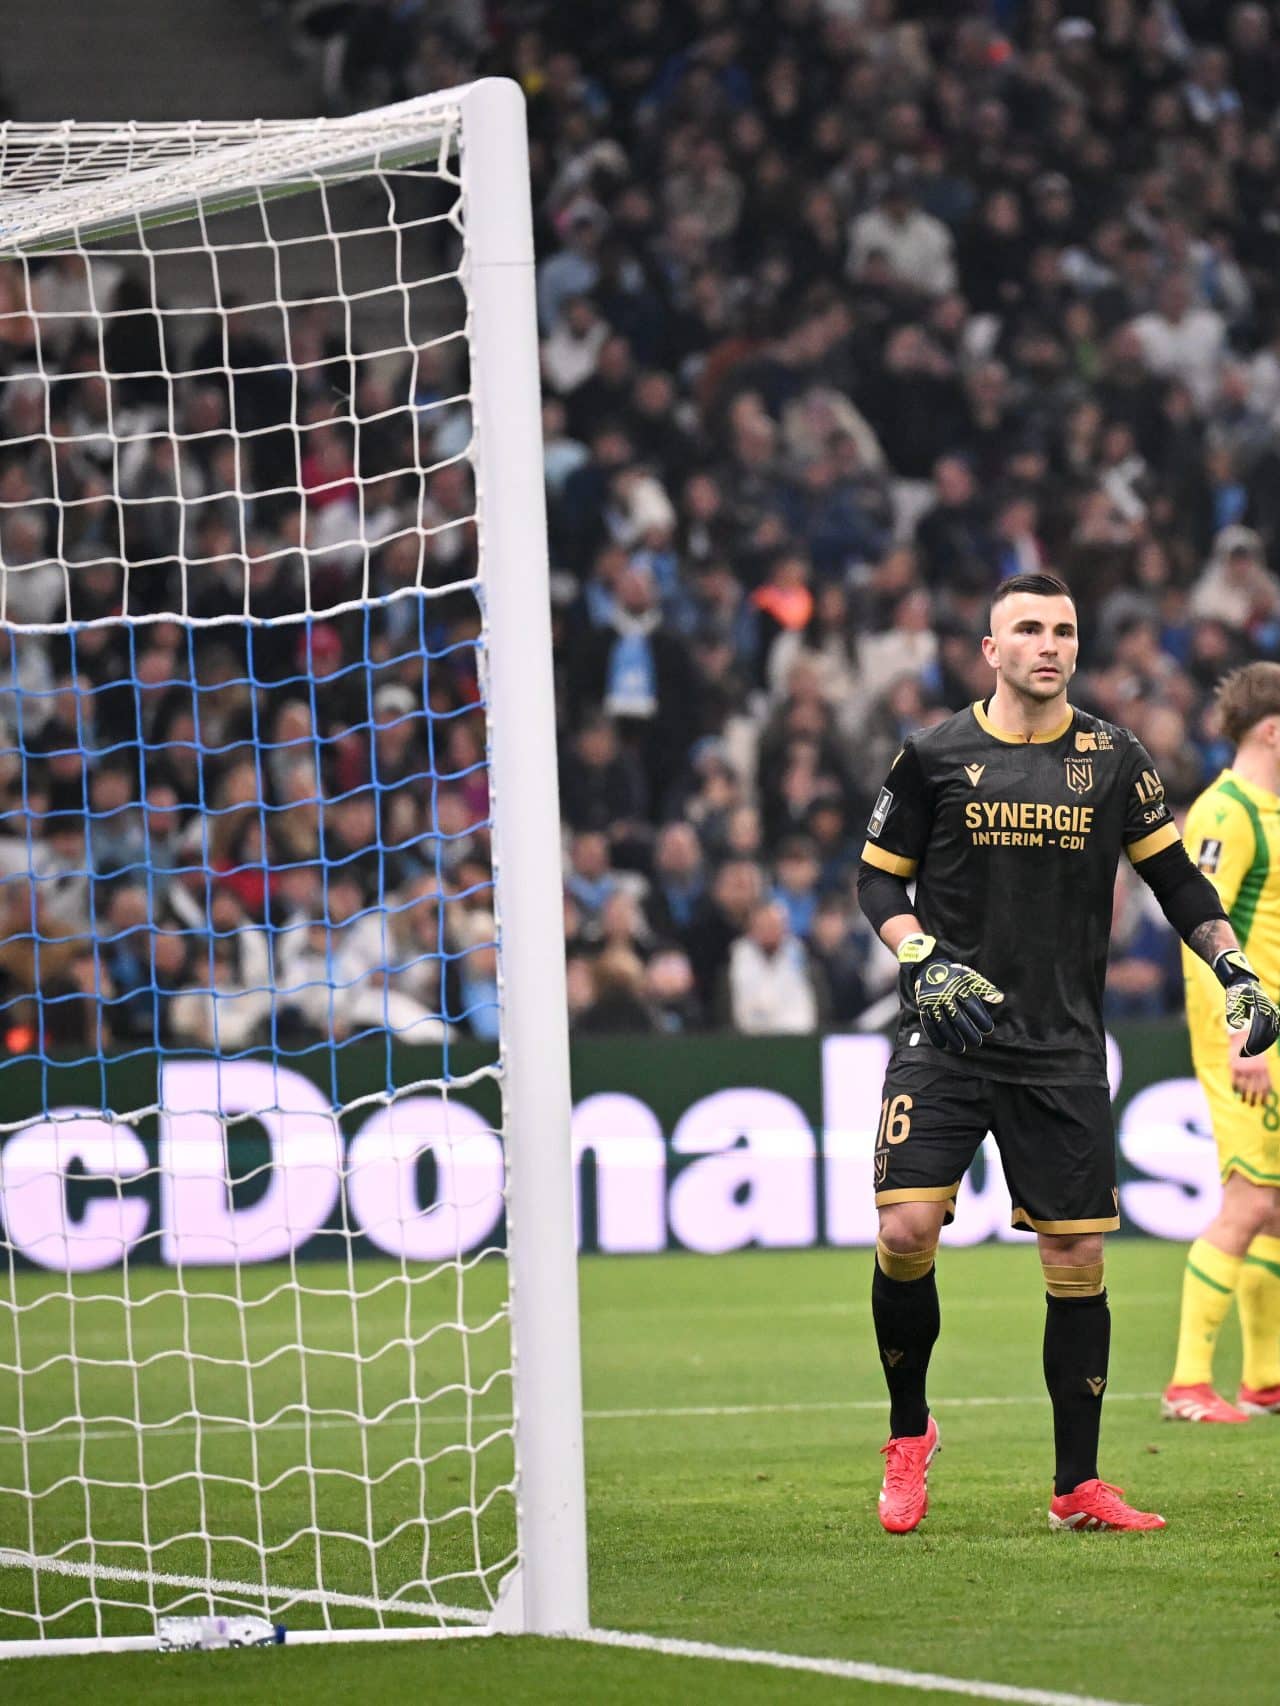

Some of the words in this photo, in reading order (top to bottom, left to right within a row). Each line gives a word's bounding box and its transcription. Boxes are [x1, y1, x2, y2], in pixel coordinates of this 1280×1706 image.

[965, 801, 1094, 833] SYNERGIE
[972, 831, 1044, 847] INTERIM
[1059, 835, 1085, 850] CDI
[877, 1094, 913, 1149] 16
